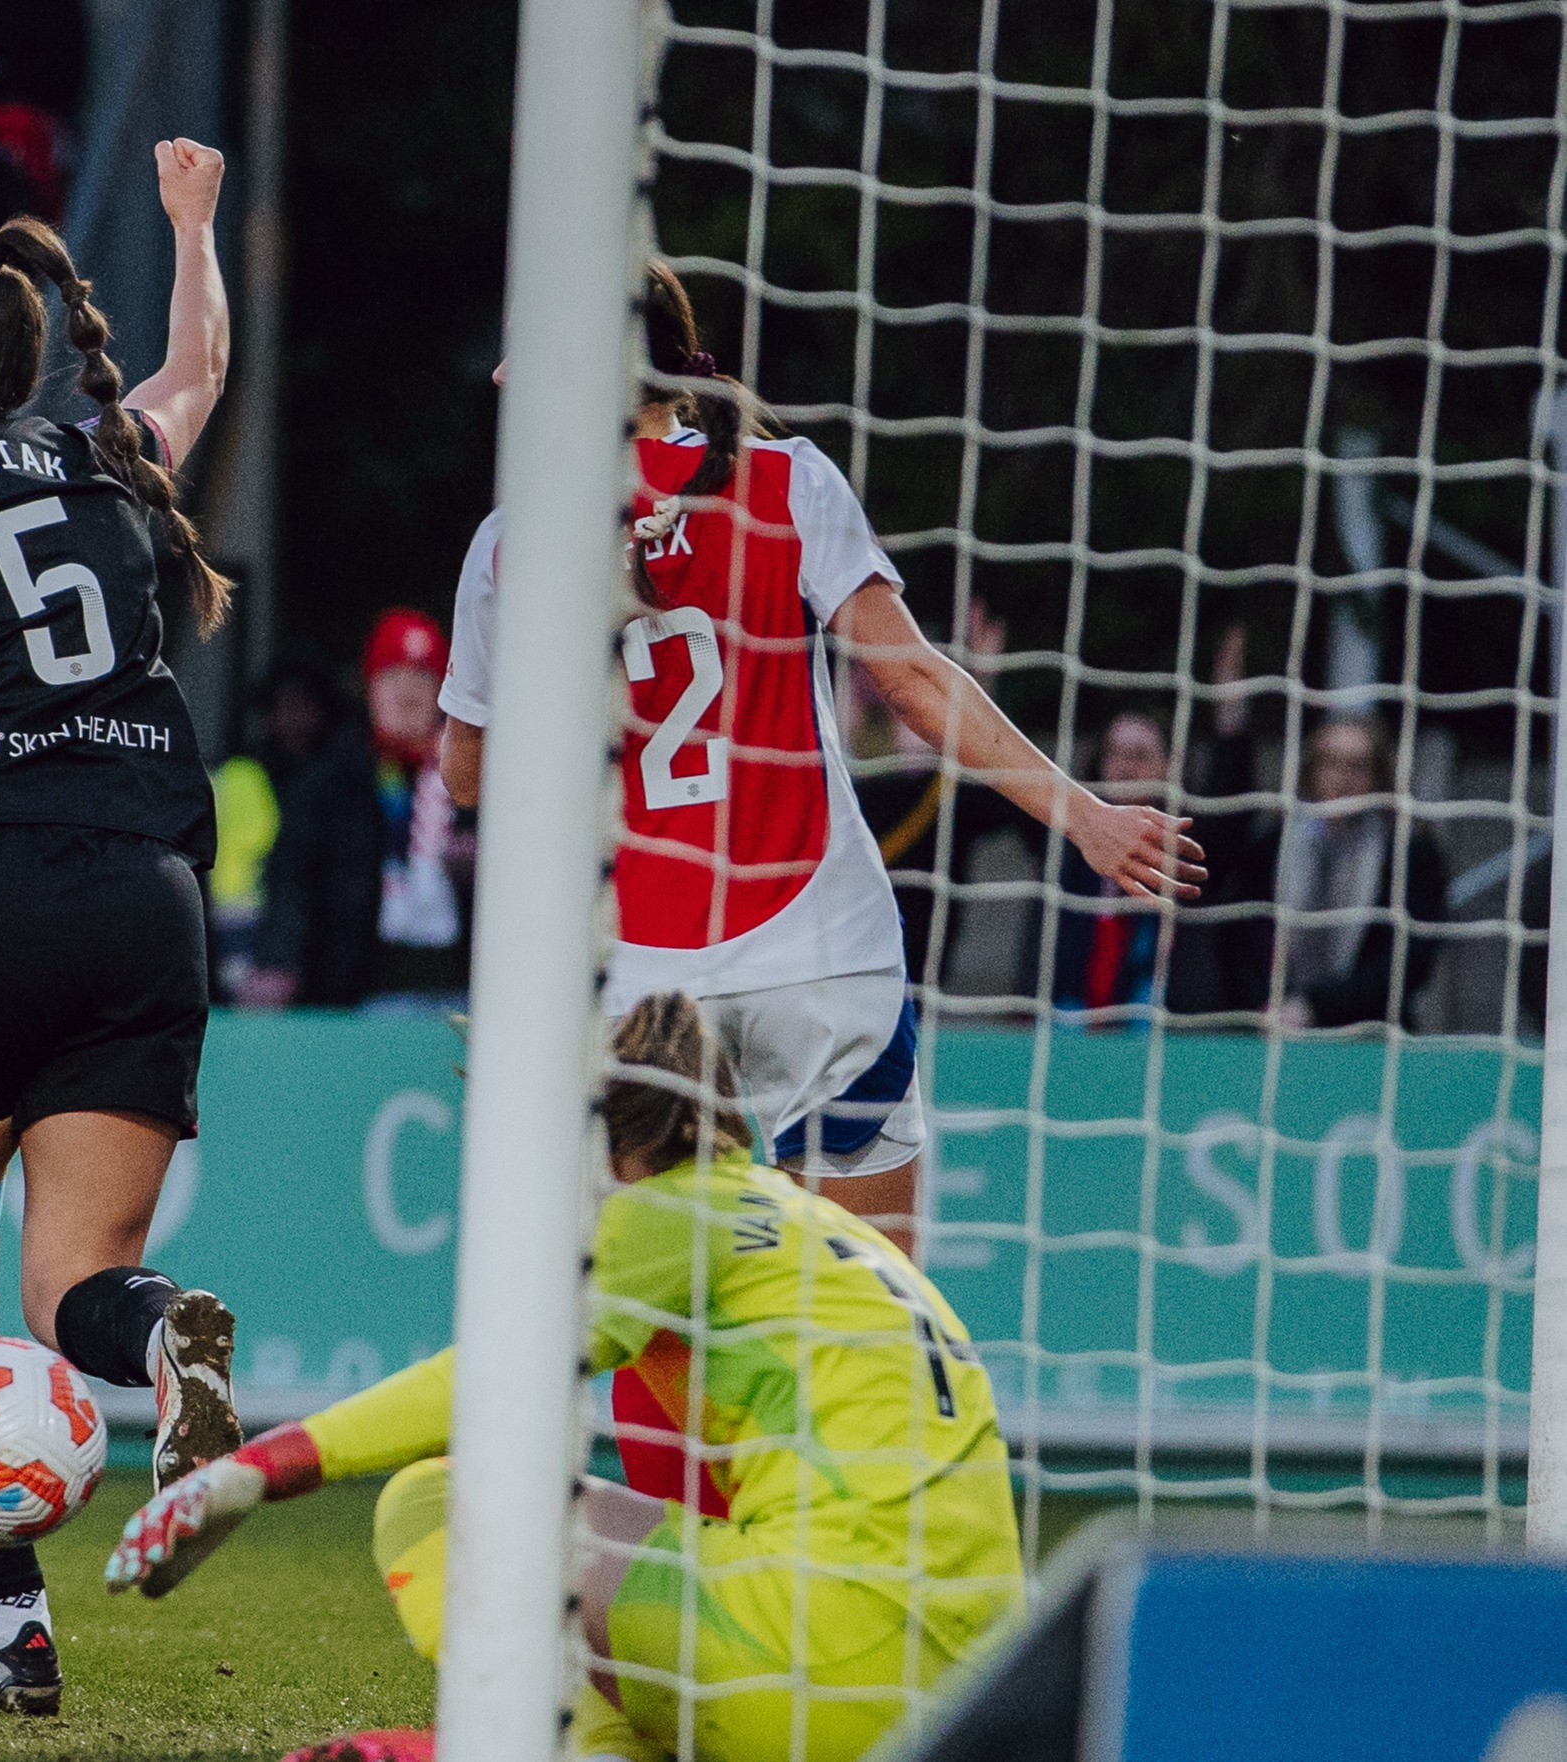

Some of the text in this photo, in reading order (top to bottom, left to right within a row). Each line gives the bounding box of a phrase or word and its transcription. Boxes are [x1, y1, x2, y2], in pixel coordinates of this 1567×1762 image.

[8, 722, 71, 758] SKIN
[74, 715, 170, 753] HEALTH
[622, 605, 731, 811] 2
